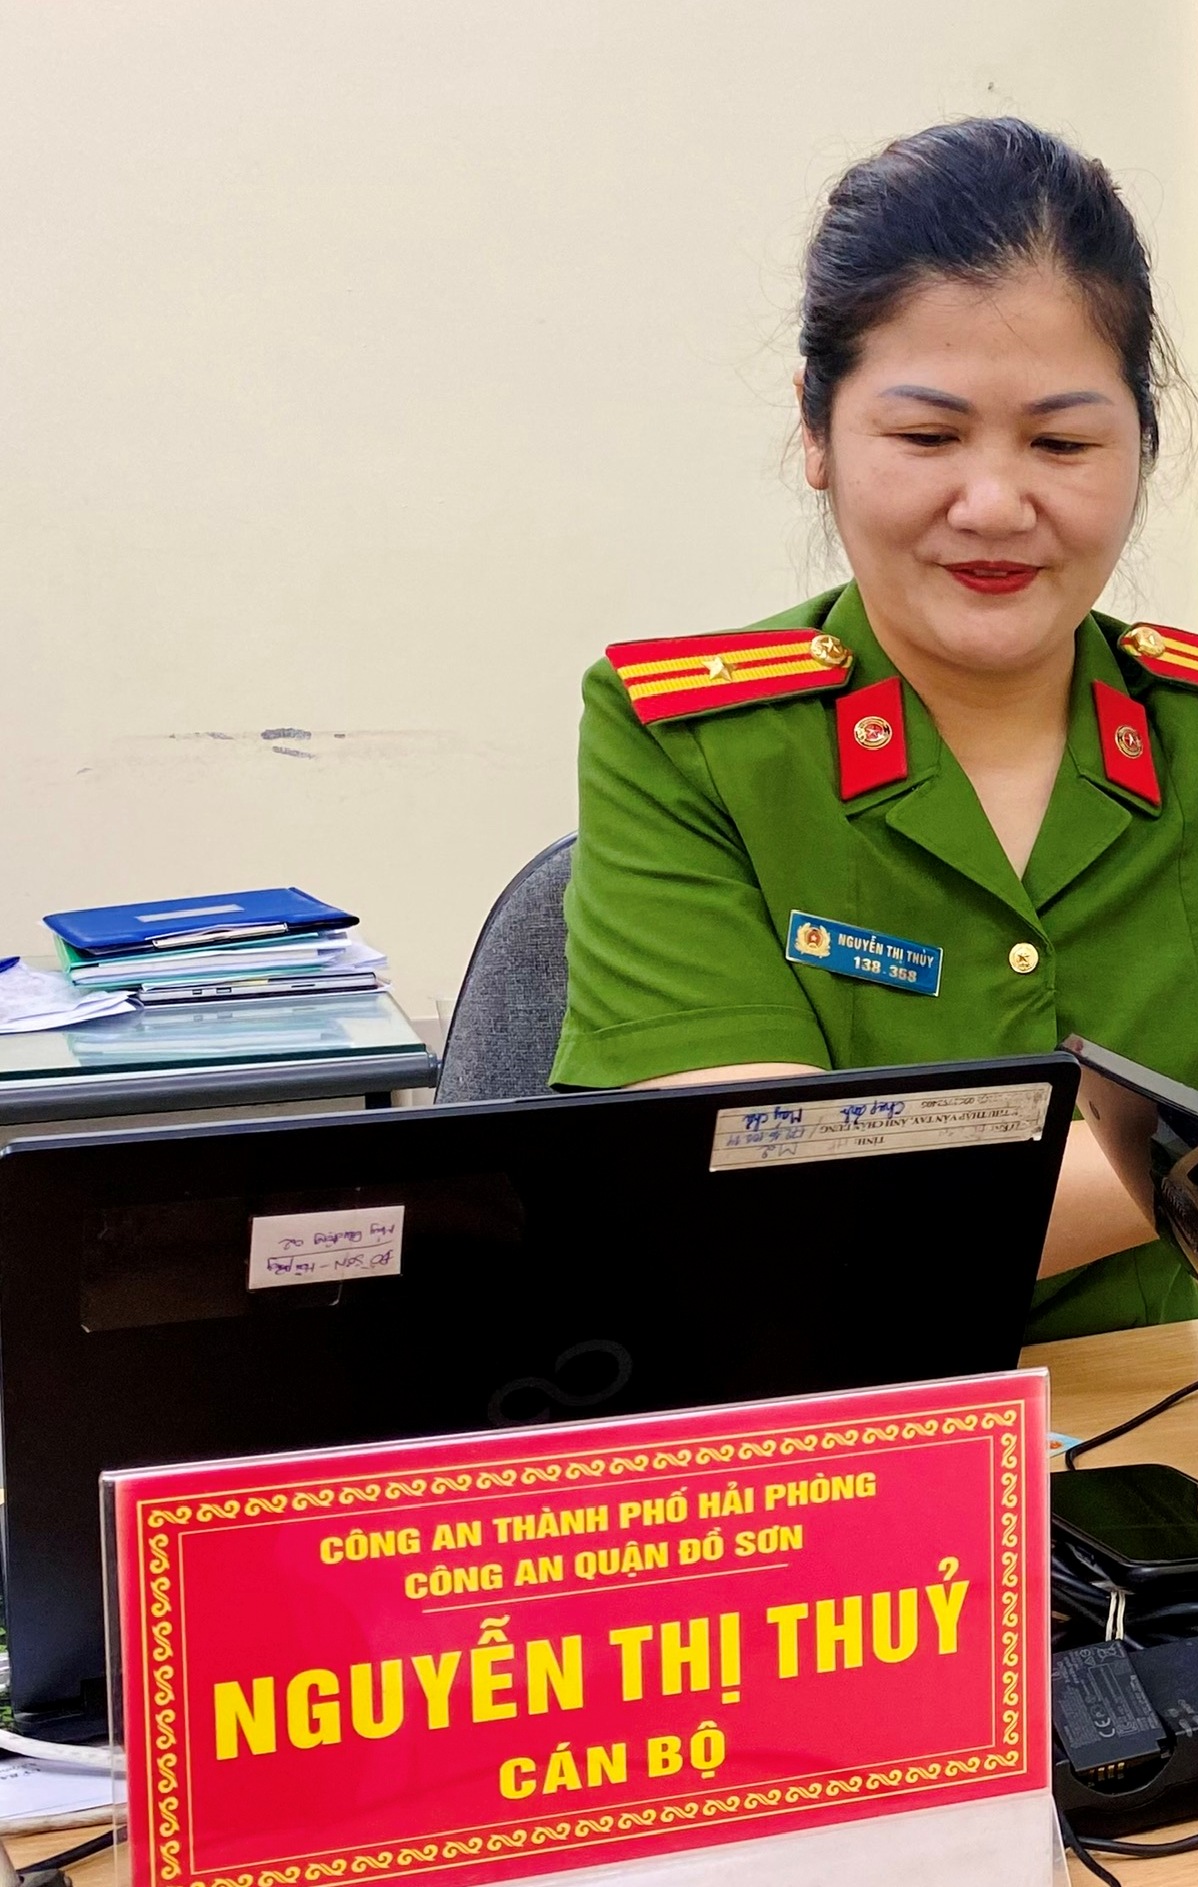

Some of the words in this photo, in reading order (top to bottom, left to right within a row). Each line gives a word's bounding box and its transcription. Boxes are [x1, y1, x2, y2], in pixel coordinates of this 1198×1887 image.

[838, 934, 883, 956] NGUYỄN
[886, 945, 904, 964] THỊ
[853, 956, 881, 974] 138
[320, 1528, 421, 1565] CÔNG
[431, 1520, 482, 1551] AN
[493, 1503, 609, 1544] THÀNH
[619, 1485, 688, 1529] PHỐ
[699, 1479, 755, 1519] HẢI
[765, 1470, 877, 1511] PHÒNG
[404, 1563, 504, 1600] CÔNG
[514, 1555, 564, 1587] AN
[575, 1540, 669, 1582] QUẬN
[678, 1526, 724, 1566] ĐỒ
[735, 1525, 803, 1557] SƠN
[214, 1613, 584, 1761] NGUYỄN
[608, 1611, 741, 1705] THỊ
[766, 1556, 970, 1679] THUỶ
[499, 1741, 628, 1800] CÁN
[647, 1720, 726, 1779] BỘ
